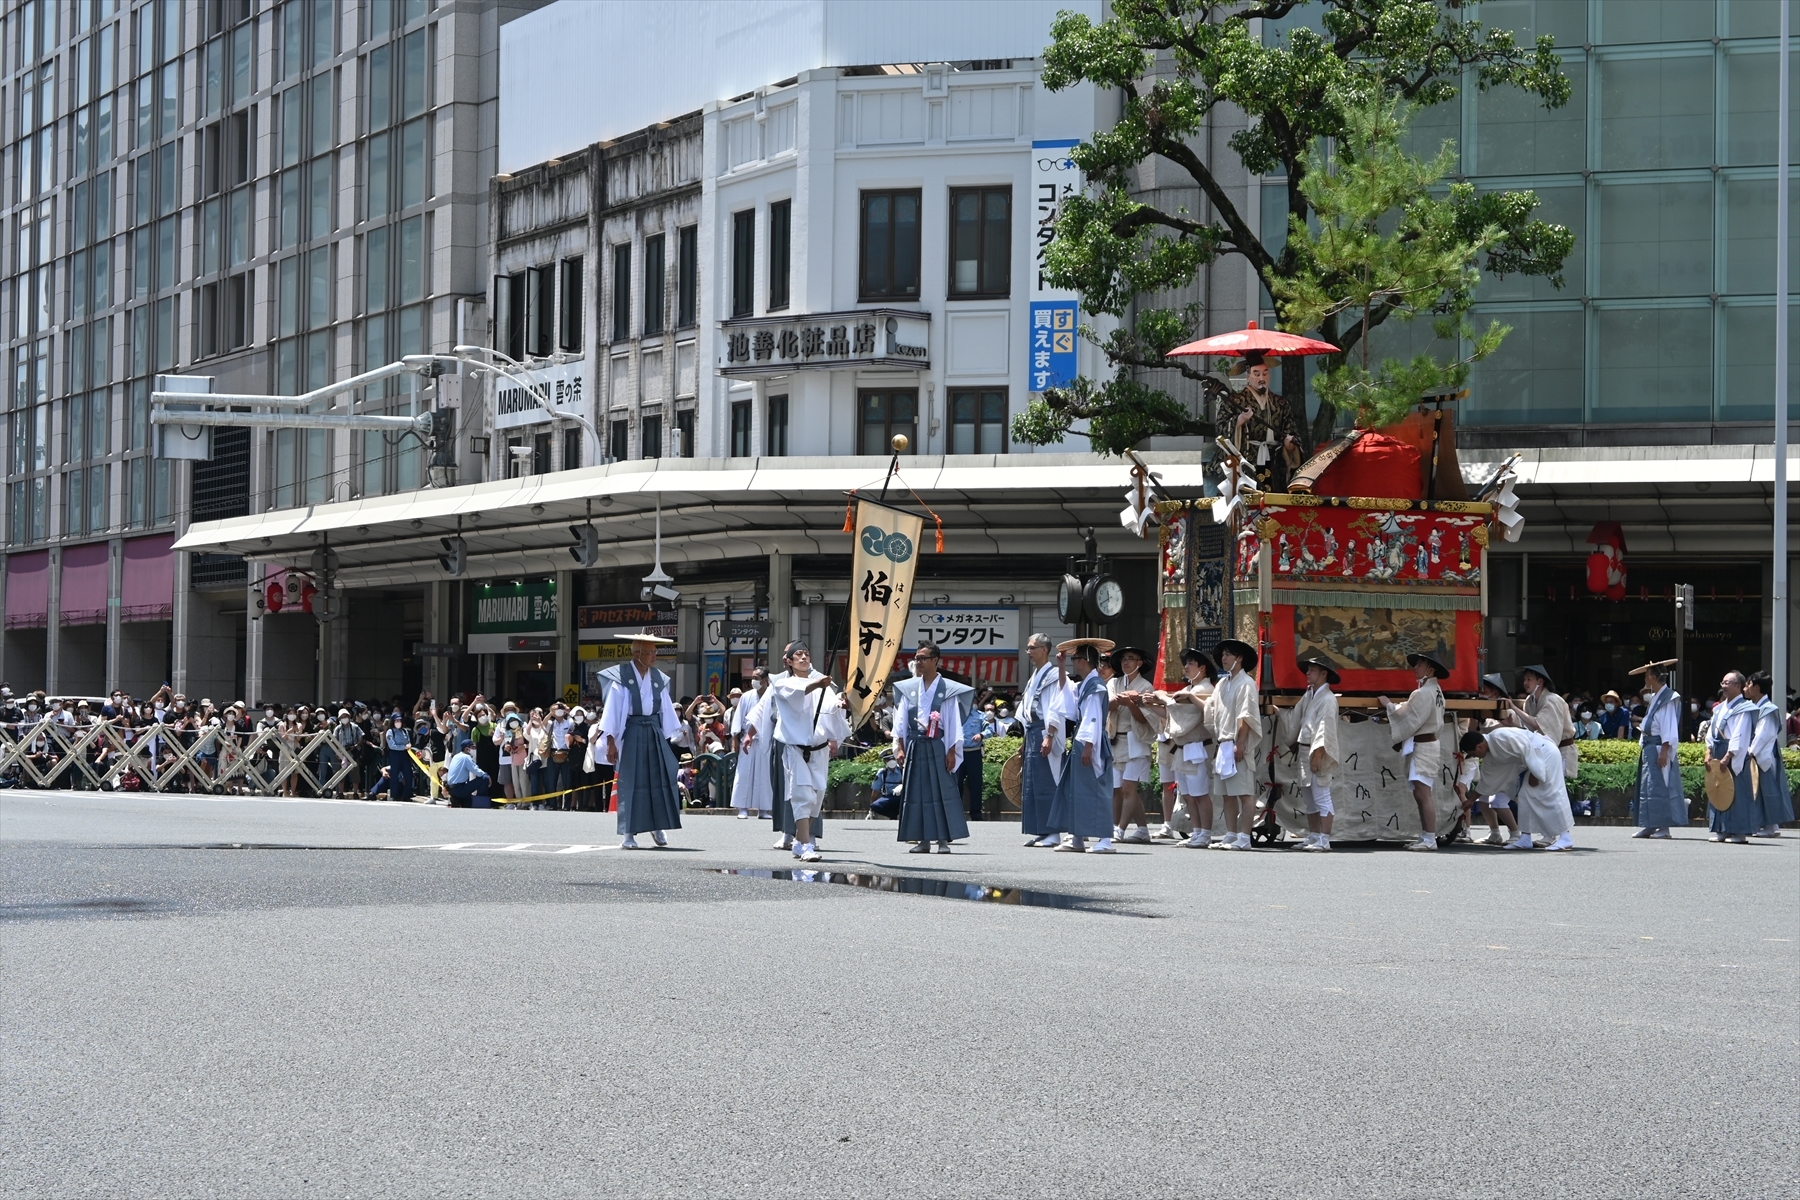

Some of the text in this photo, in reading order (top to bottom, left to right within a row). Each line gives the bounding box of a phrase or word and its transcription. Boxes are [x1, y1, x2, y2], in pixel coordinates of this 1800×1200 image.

[1055, 310, 1072, 352] すぐ
[727, 323, 876, 363] 池善化粧品店
[1033, 310, 1052, 389] 買えます
[555, 376, 582, 405] 雲の茶
[478, 596, 529, 623] MARUMARU
[591, 608, 656, 623] アクセスチケット
[946, 613, 1005, 624] メガネスーパー
[918, 627, 1005, 646] コンタクト
[1664, 629, 1732, 641] Taashimaya
[597, 645, 616, 658] Money
